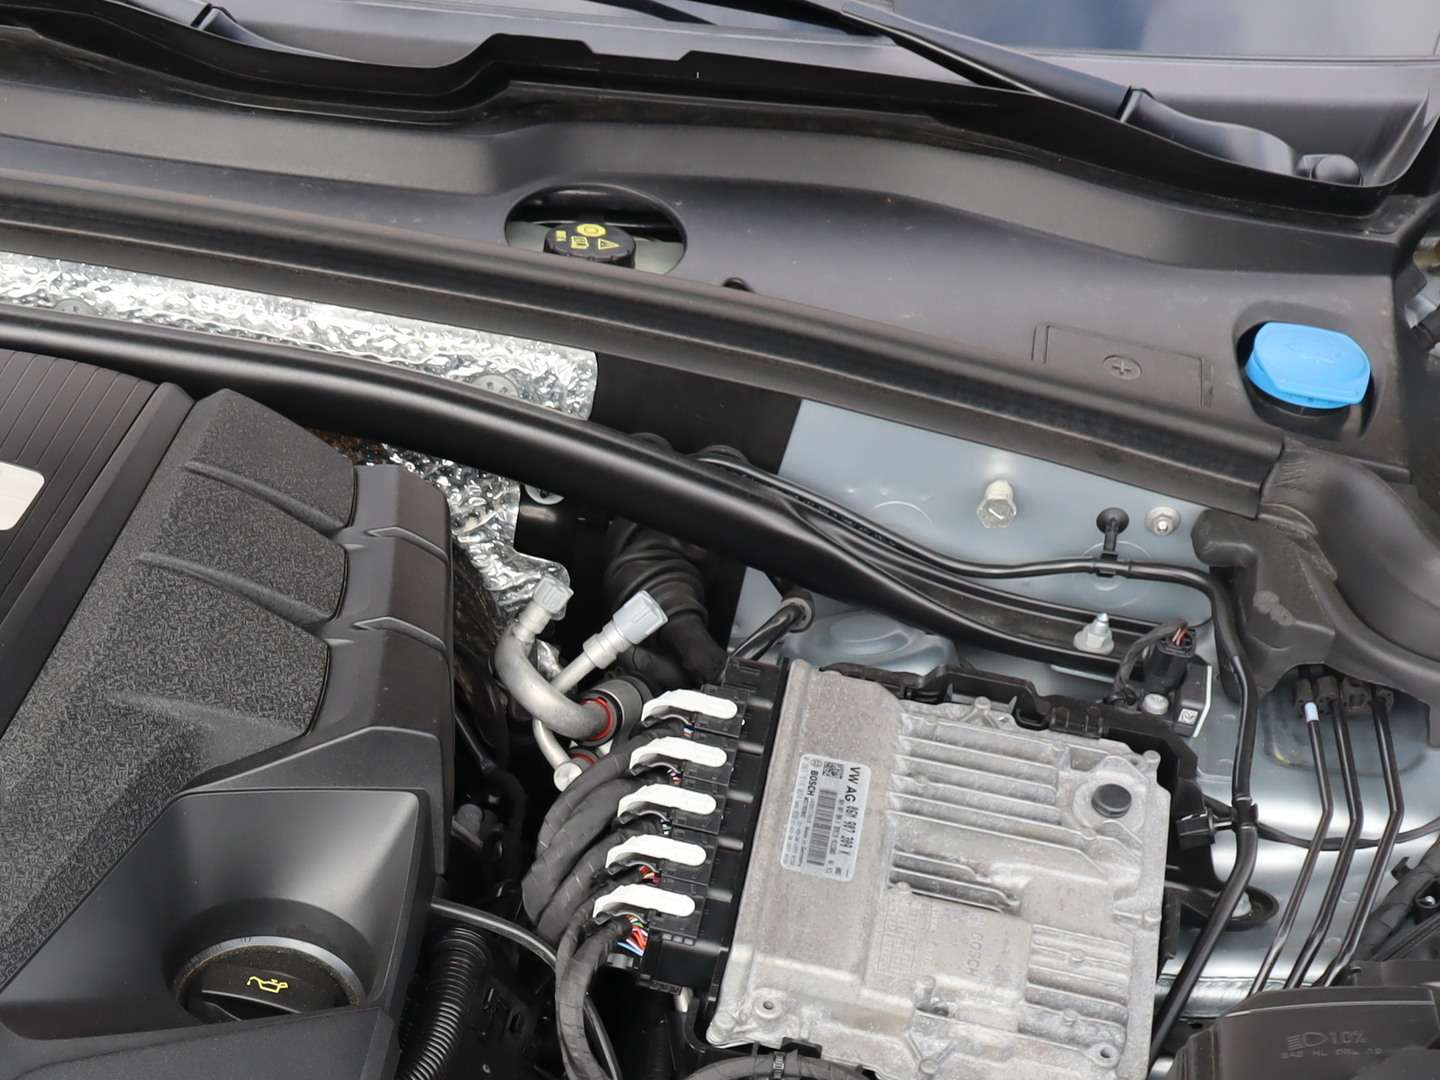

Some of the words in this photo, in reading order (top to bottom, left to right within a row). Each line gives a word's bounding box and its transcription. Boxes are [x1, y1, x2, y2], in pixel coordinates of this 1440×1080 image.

[807, 770, 819, 796] BOSCH
[847, 766, 861, 785] VW
[844, 786, 857, 802] AG
